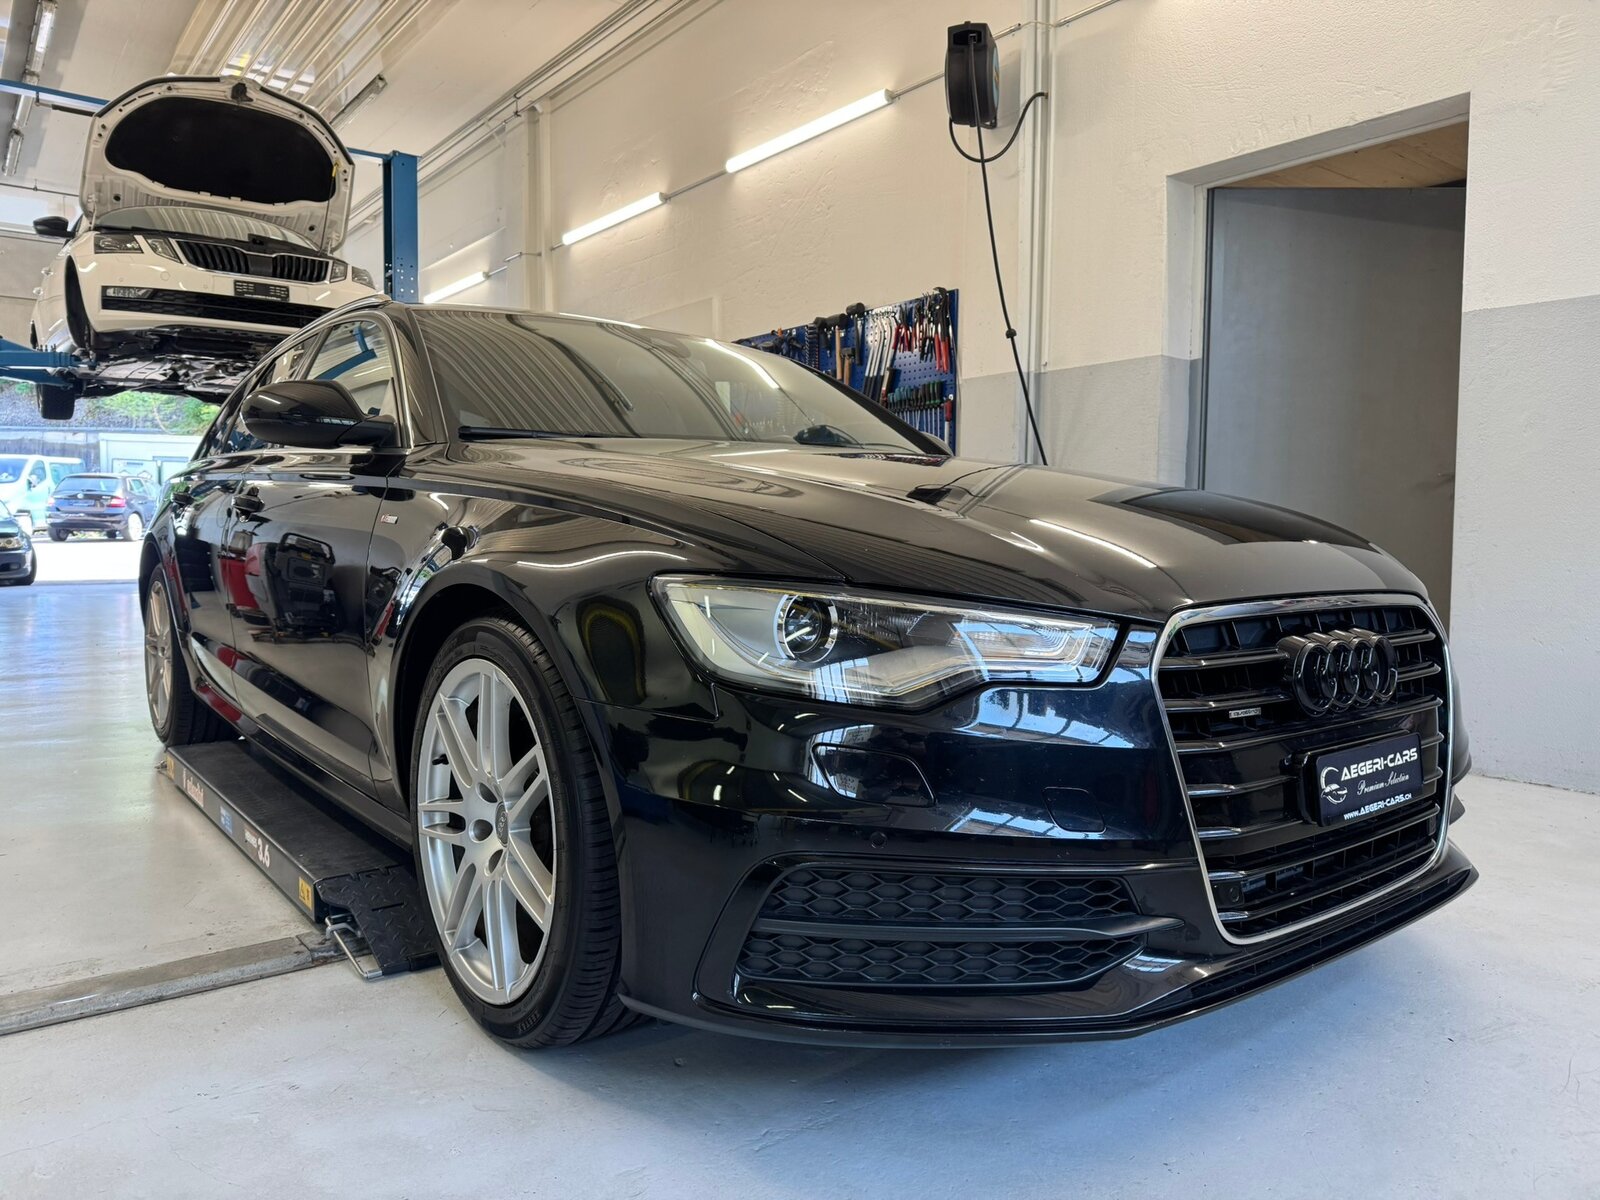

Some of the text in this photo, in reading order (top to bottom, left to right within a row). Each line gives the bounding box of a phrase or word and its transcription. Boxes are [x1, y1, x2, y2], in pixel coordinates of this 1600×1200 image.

[1340, 747, 1418, 782] AEGERI-CARS
[1356, 770, 1410, 796] Premium Selection
